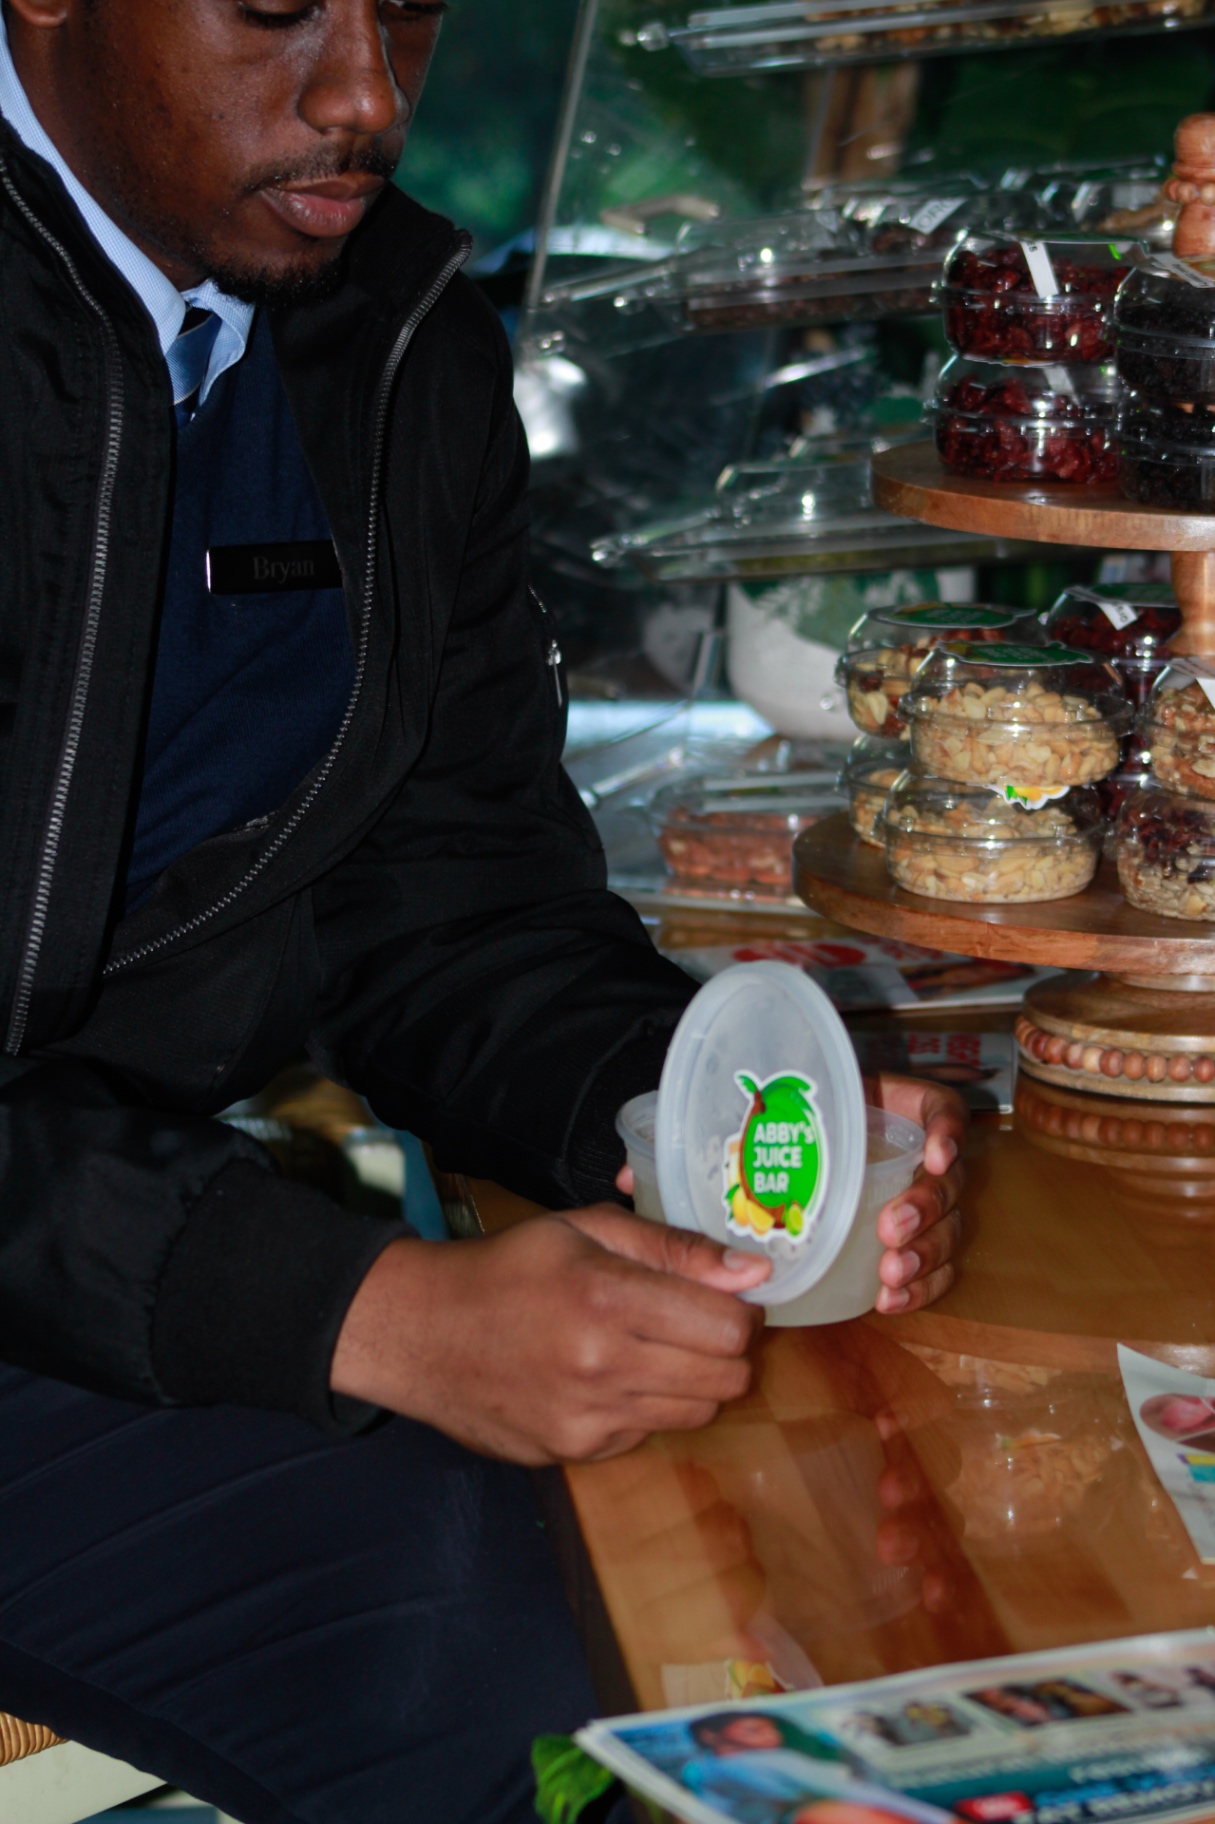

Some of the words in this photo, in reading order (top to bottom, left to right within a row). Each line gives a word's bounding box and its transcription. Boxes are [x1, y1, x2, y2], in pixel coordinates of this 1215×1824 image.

[254, 556, 314, 583] Bryan
[753, 1146, 802, 1168] JUICE
[753, 1171, 790, 1194] BAR
